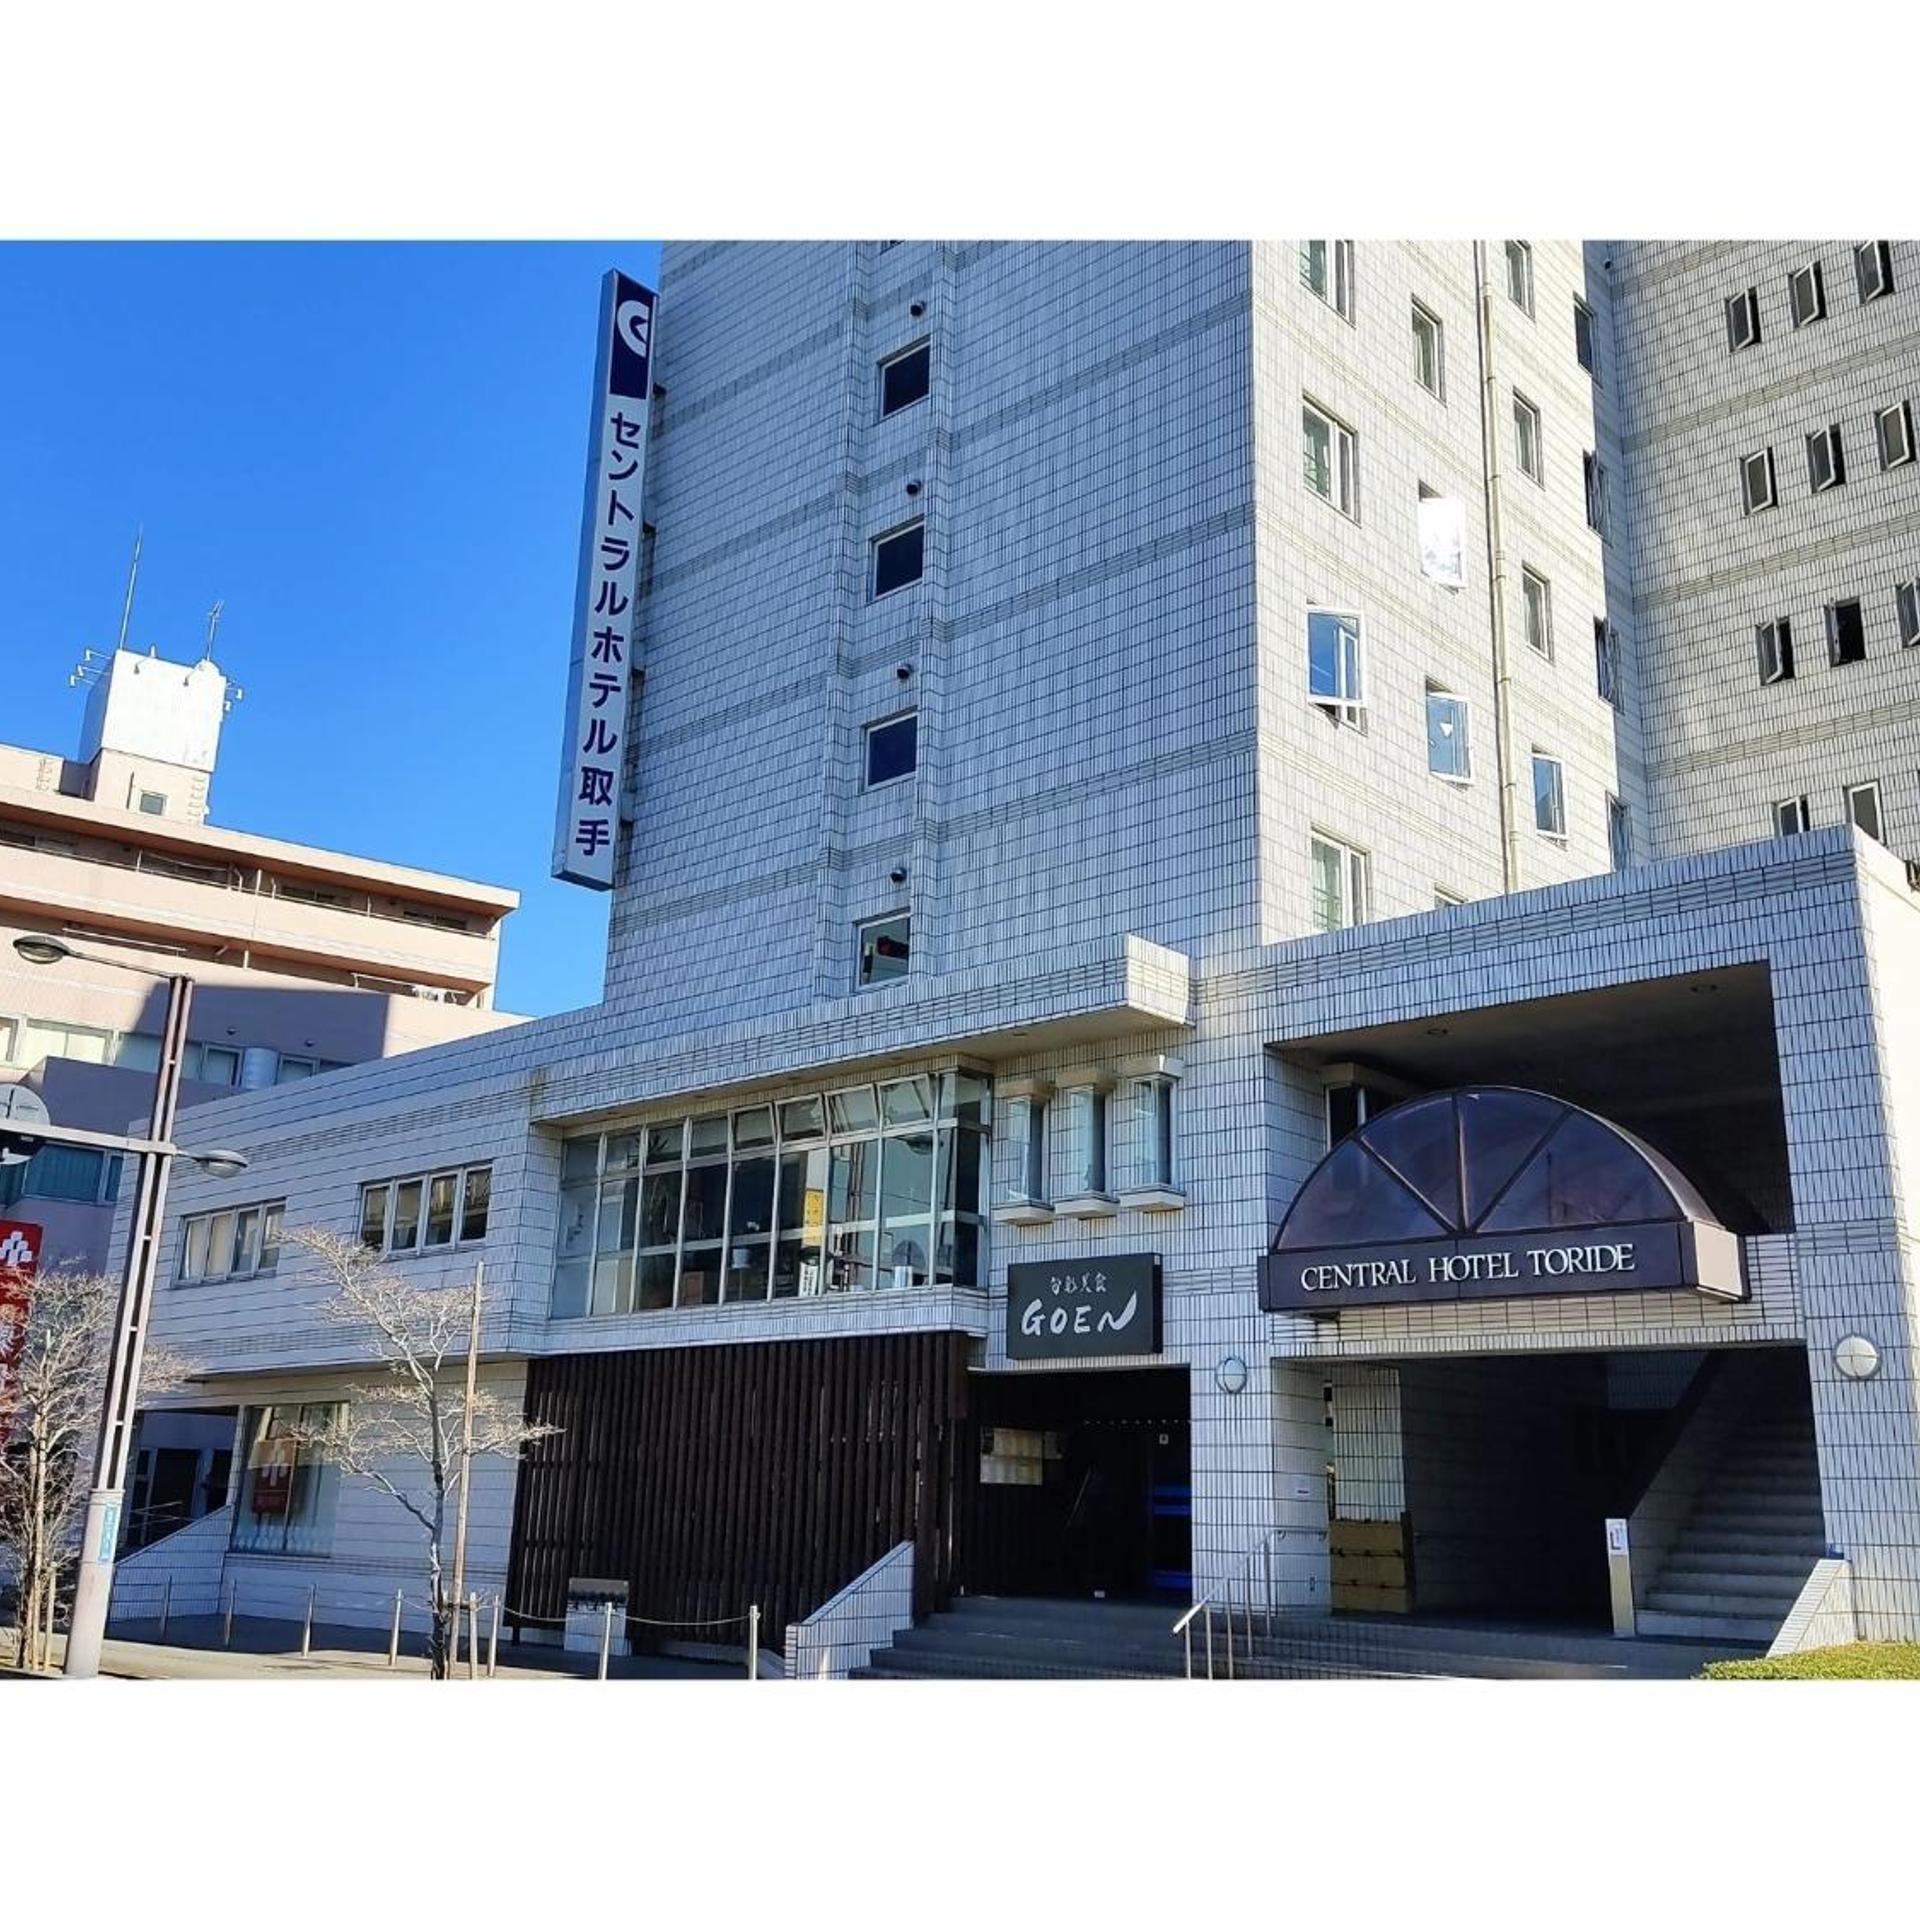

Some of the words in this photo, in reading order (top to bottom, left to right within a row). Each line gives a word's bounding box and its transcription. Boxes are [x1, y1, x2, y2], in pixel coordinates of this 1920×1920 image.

[575, 411, 642, 857] セントラルホテル取手
[1300, 1258, 1417, 1291] CENTRAL
[1428, 1251, 1520, 1283] HOTEL
[1527, 1243, 1636, 1276] TORIDE
[1020, 1289, 1138, 1337] GOEN
